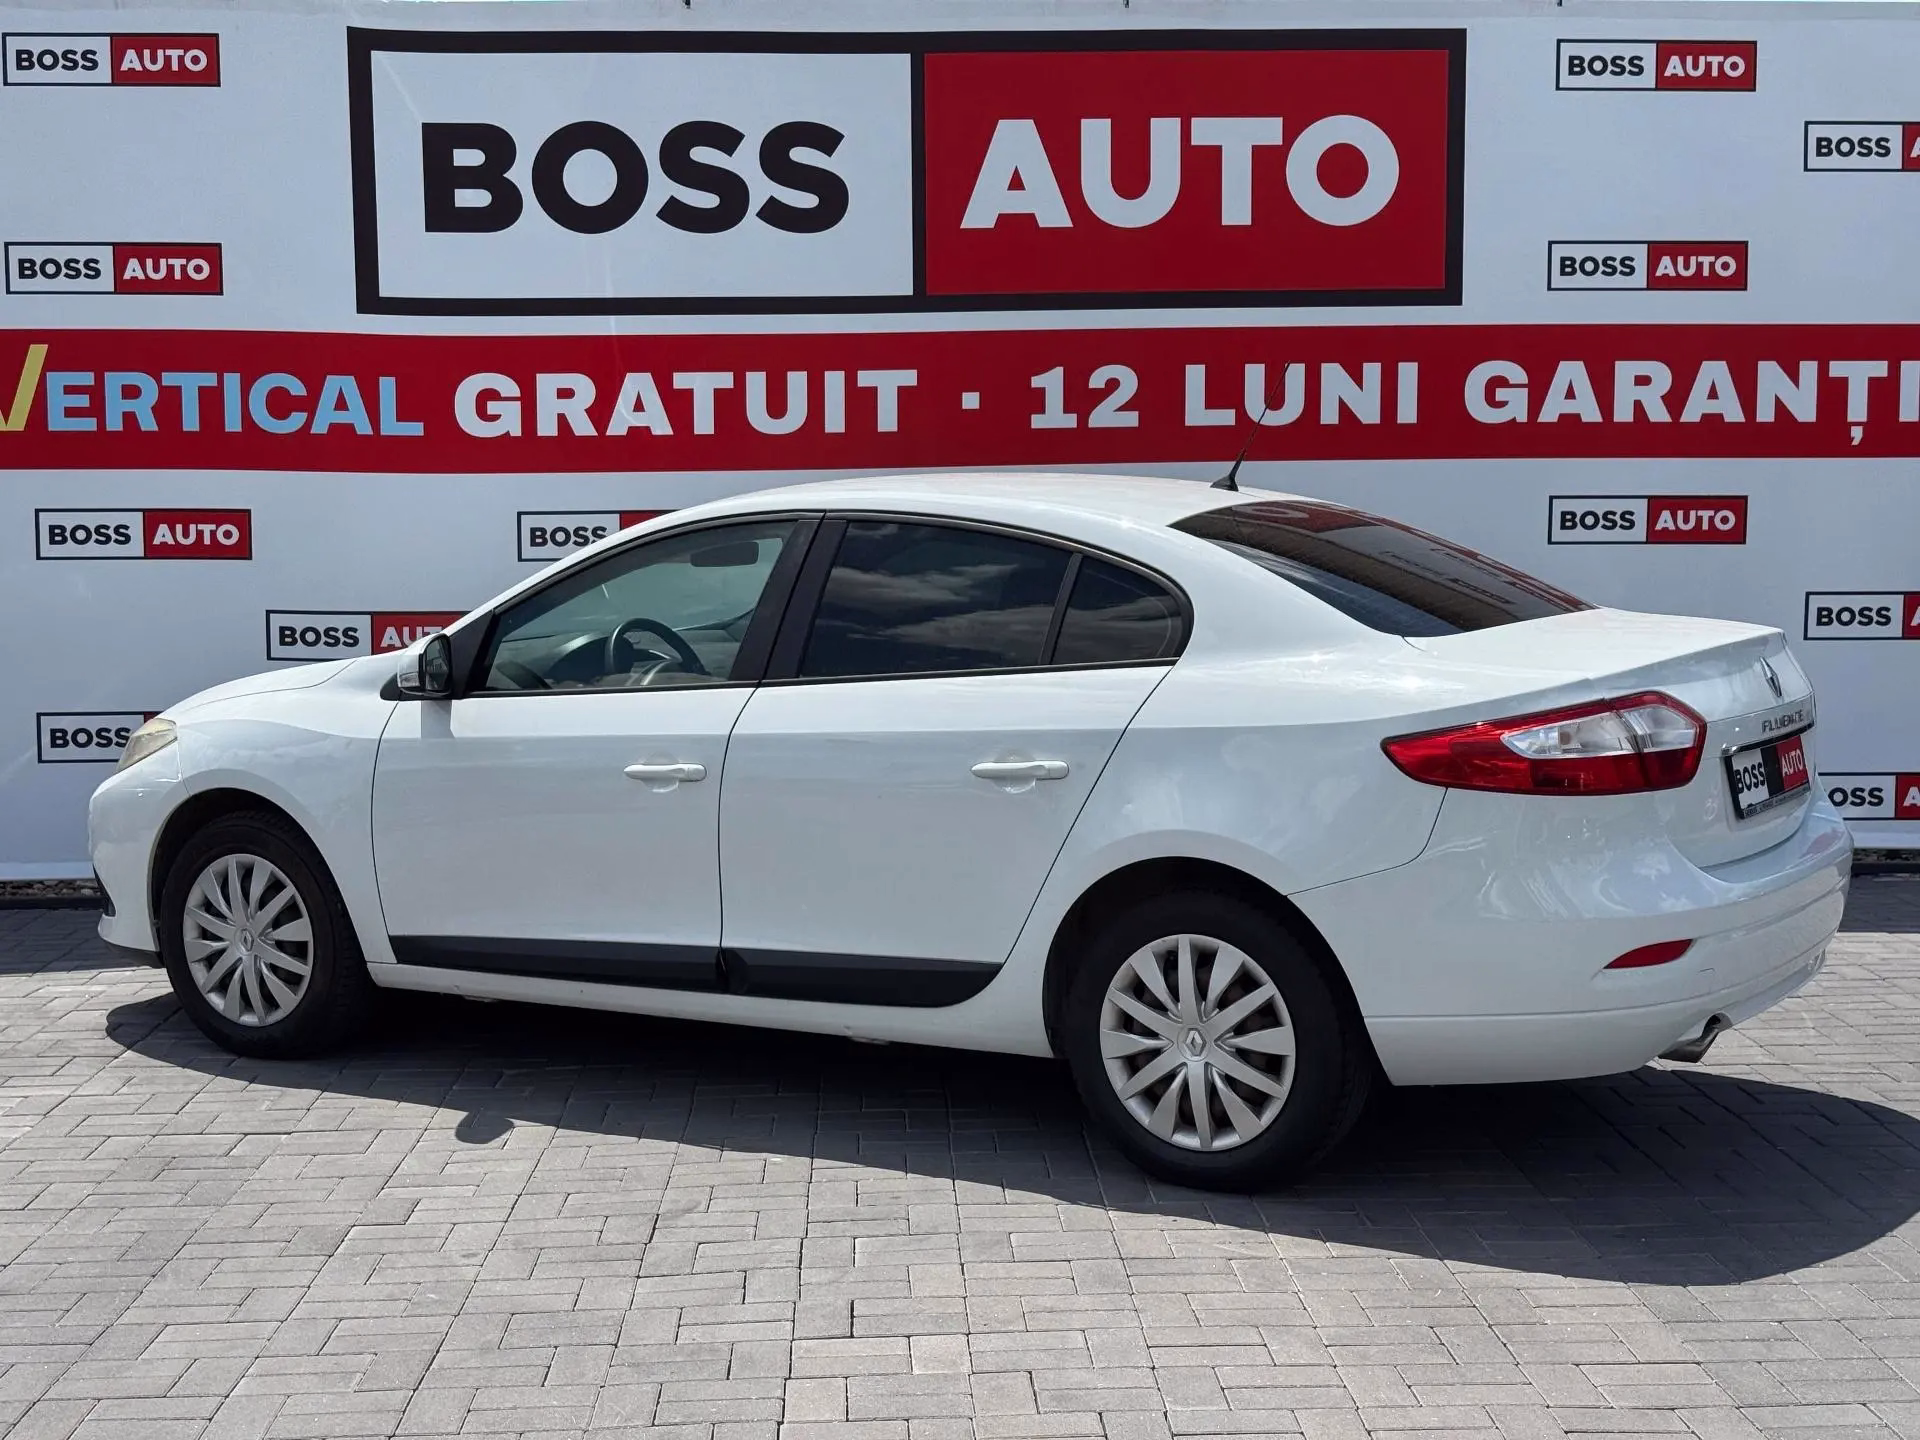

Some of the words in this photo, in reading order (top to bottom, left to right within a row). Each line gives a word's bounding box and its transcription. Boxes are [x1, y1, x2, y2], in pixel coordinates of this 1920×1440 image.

[16, 49, 98, 71] BOSS
[121, 49, 207, 71] AUTO
[1567, 56, 1645, 77] BOSS
[1664, 56, 1745, 77] AUTO
[1815, 136, 1891, 157] BOSS
[422, 121, 849, 234] BOSS
[960, 115, 1399, 228] AUTO
[18, 258, 101, 279] BOSS
[123, 259, 209, 280] AUTO
[1559, 256, 1635, 276] BOSS
[1656, 256, 1736, 277] AUTO
[455, 370, 917, 437] GRATUIT
[1031, 365, 1138, 428] 12
[1185, 363, 1418, 426] LUNI
[1559, 510, 1635, 531] BOSS
[1655, 510, 1736, 531] AUTO
[49, 524, 131, 545] BOSS
[153, 524, 239, 545] AUTO
[1816, 606, 1892, 627] BOSS
[279, 626, 359, 648] BOSS
[49, 727, 132, 749] BOSS
[1734, 762, 1766, 794] BOSS
[1781, 748, 1804, 777] AUTO
[1827, 787, 1885, 807] OSS
